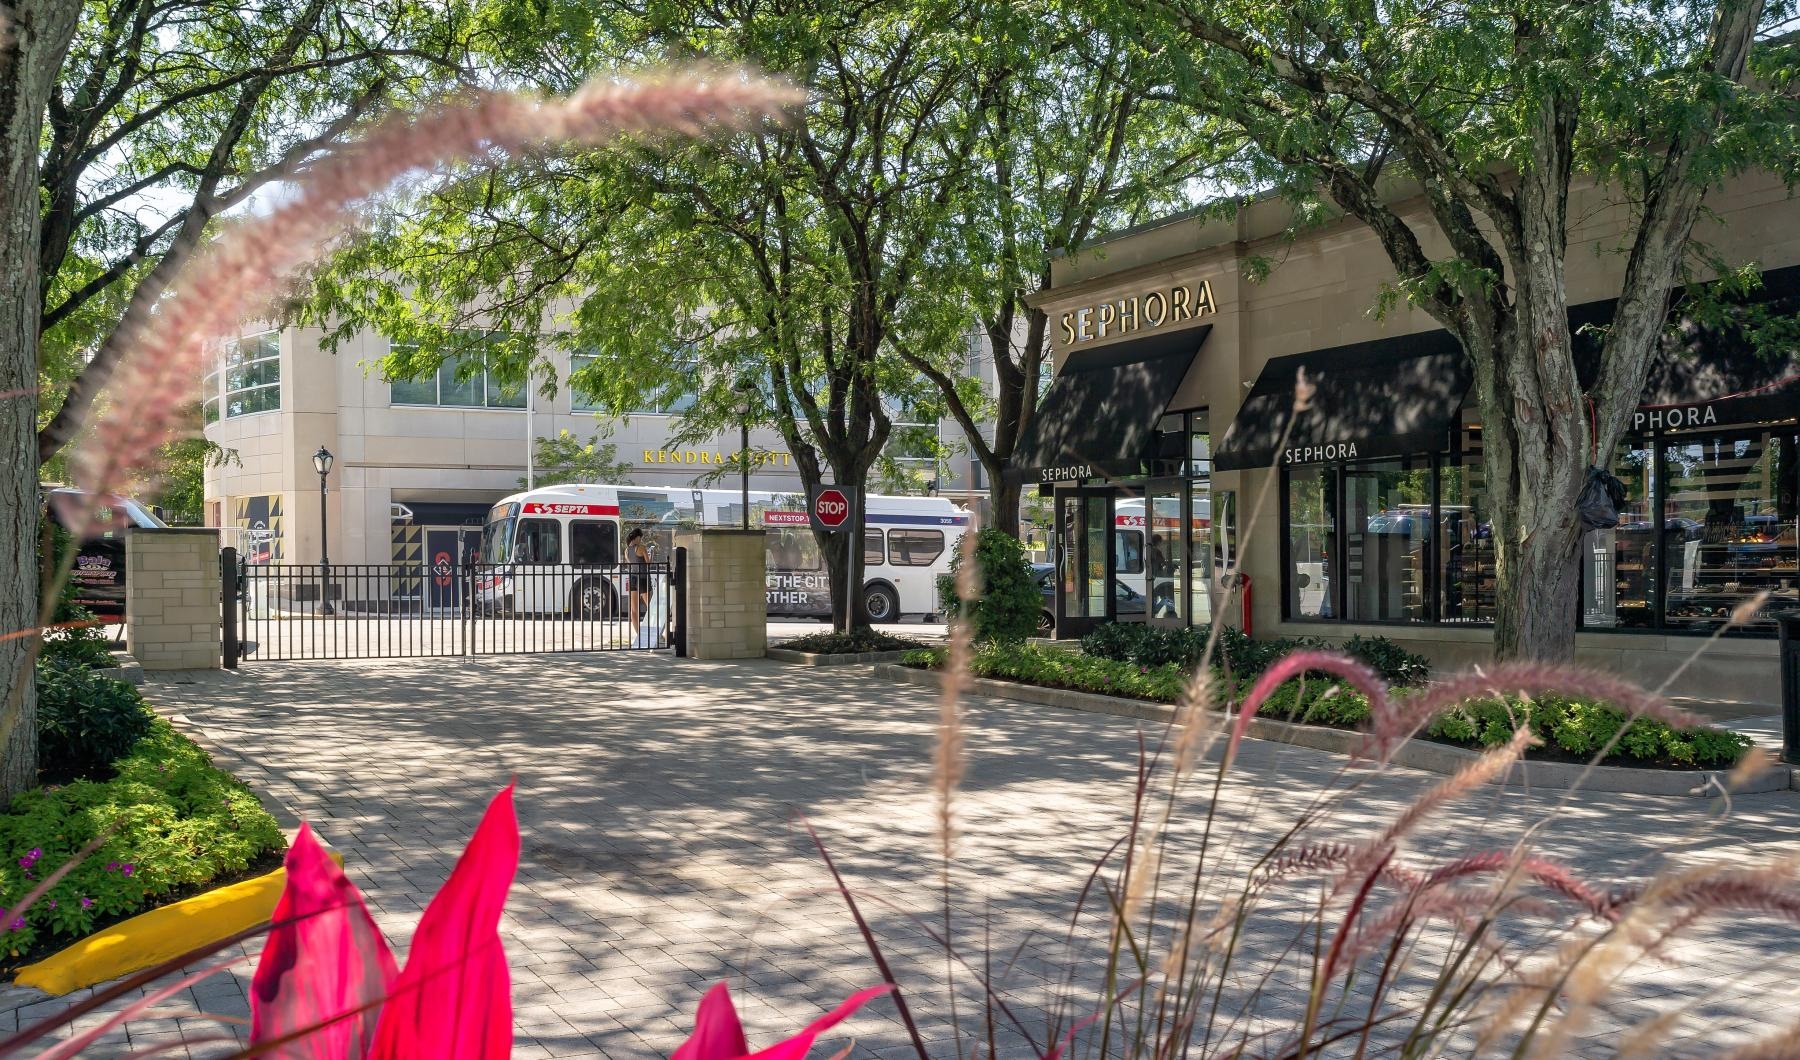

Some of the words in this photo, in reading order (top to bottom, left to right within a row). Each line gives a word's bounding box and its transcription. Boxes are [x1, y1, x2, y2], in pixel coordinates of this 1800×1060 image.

[1060, 280, 1217, 345] SEPHORA
[1634, 405, 1717, 431] PHORA
[643, 450, 724, 464] KENDRA
[1285, 442, 1357, 463] SEPHORA
[1042, 465, 1092, 481] SEPHORA
[554, 505, 589, 514] SEPTA
[818, 501, 846, 515] STOP
[775, 575, 801, 588] THE
[805, 576, 830, 588] CIT
[766, 591, 808, 603] RTHER
